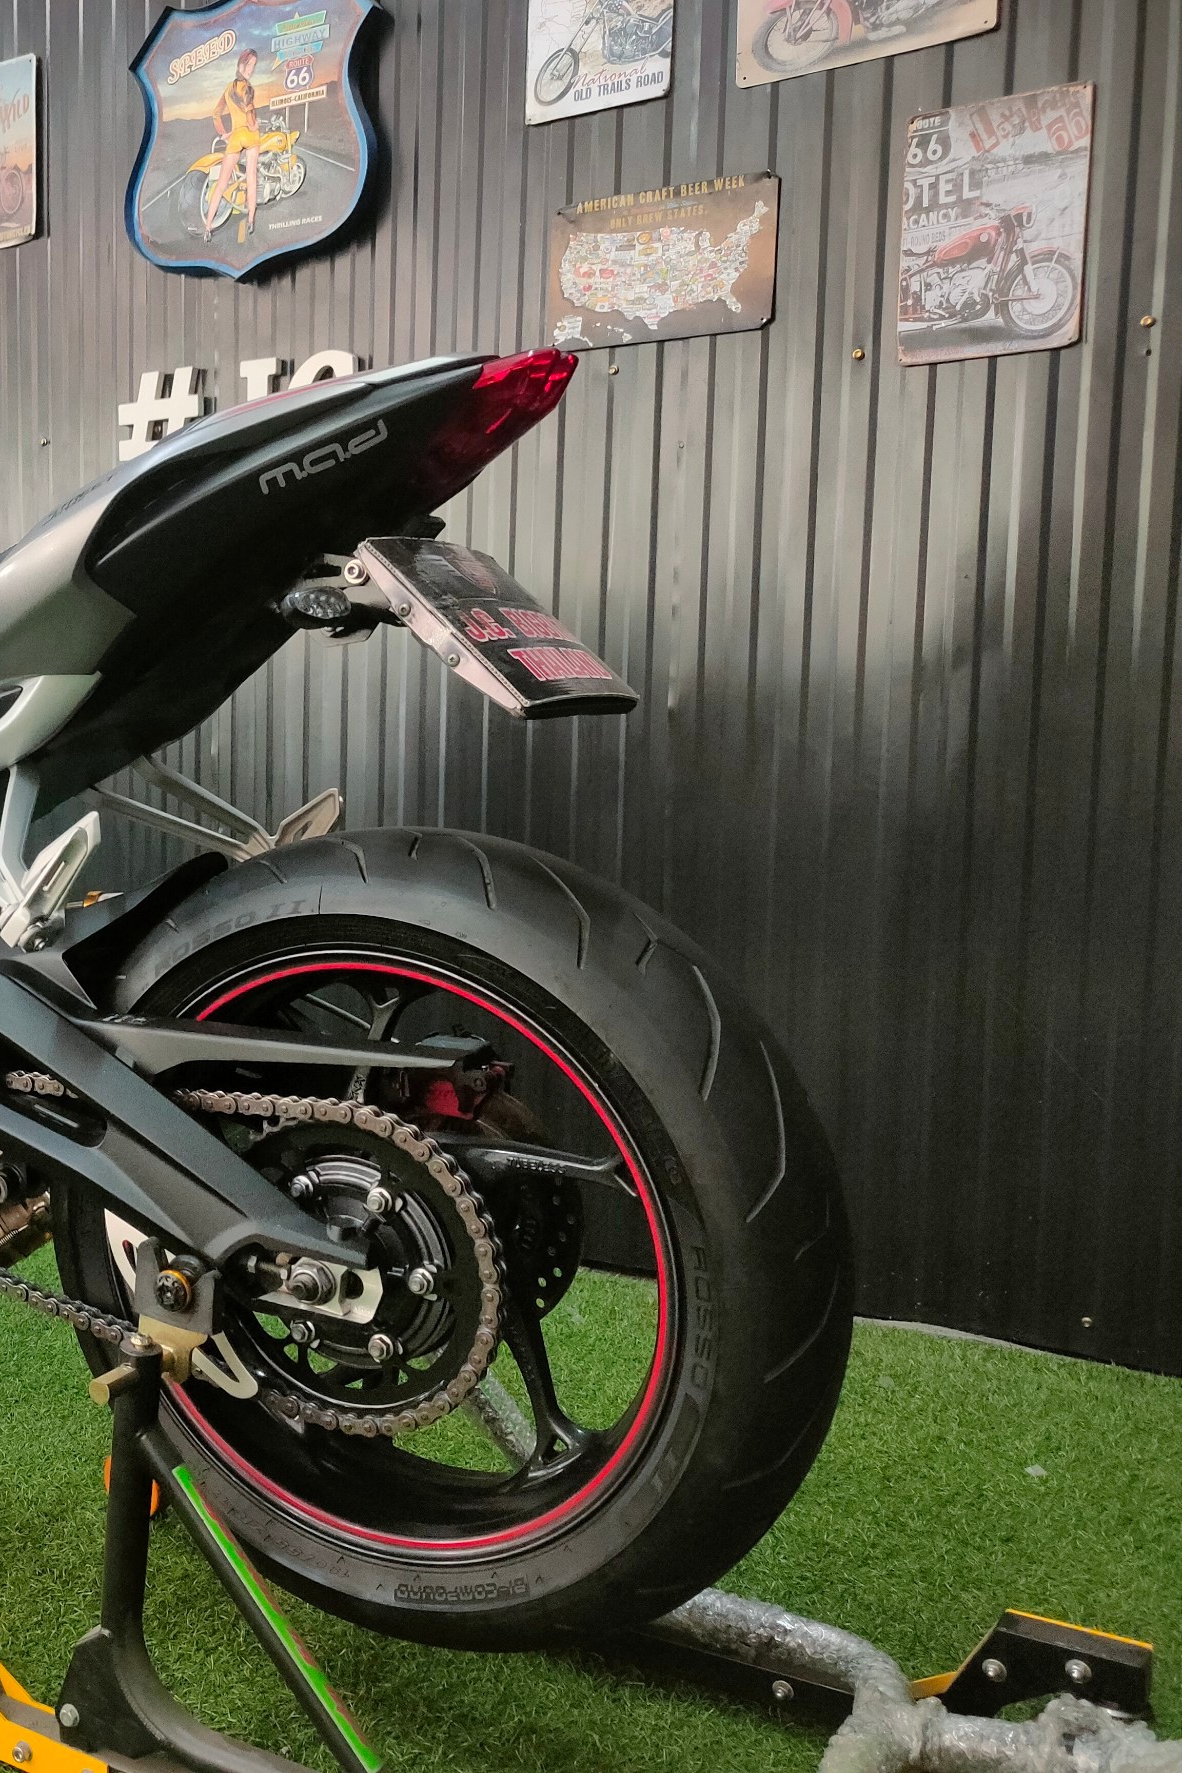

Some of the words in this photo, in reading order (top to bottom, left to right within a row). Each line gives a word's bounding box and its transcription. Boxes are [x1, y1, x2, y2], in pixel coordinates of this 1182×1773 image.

[273, 29, 326, 49] HIGHWAY
[168, 29, 236, 84] SPEED
[289, 58, 309, 68] ROUTE
[287, 67, 309, 89] 66
[572, 56, 648, 89] National
[573, 87, 592, 102] OLD
[598, 78, 631, 97] TRAILS
[636, 71, 664, 88] ROAD
[906, 134, 943, 164] 66
[576, 193, 634, 215] AMERICAN
[639, 186, 675, 204] CRAFT
[680, 181, 709, 197] BEER
[714, 175, 745, 191] WEEK
[268, 219, 300, 230] THRILLING
[302, 215, 322, 224] RACES
[636, 212, 663, 226] BREW
[507, 646, 613, 681] THAILAND
